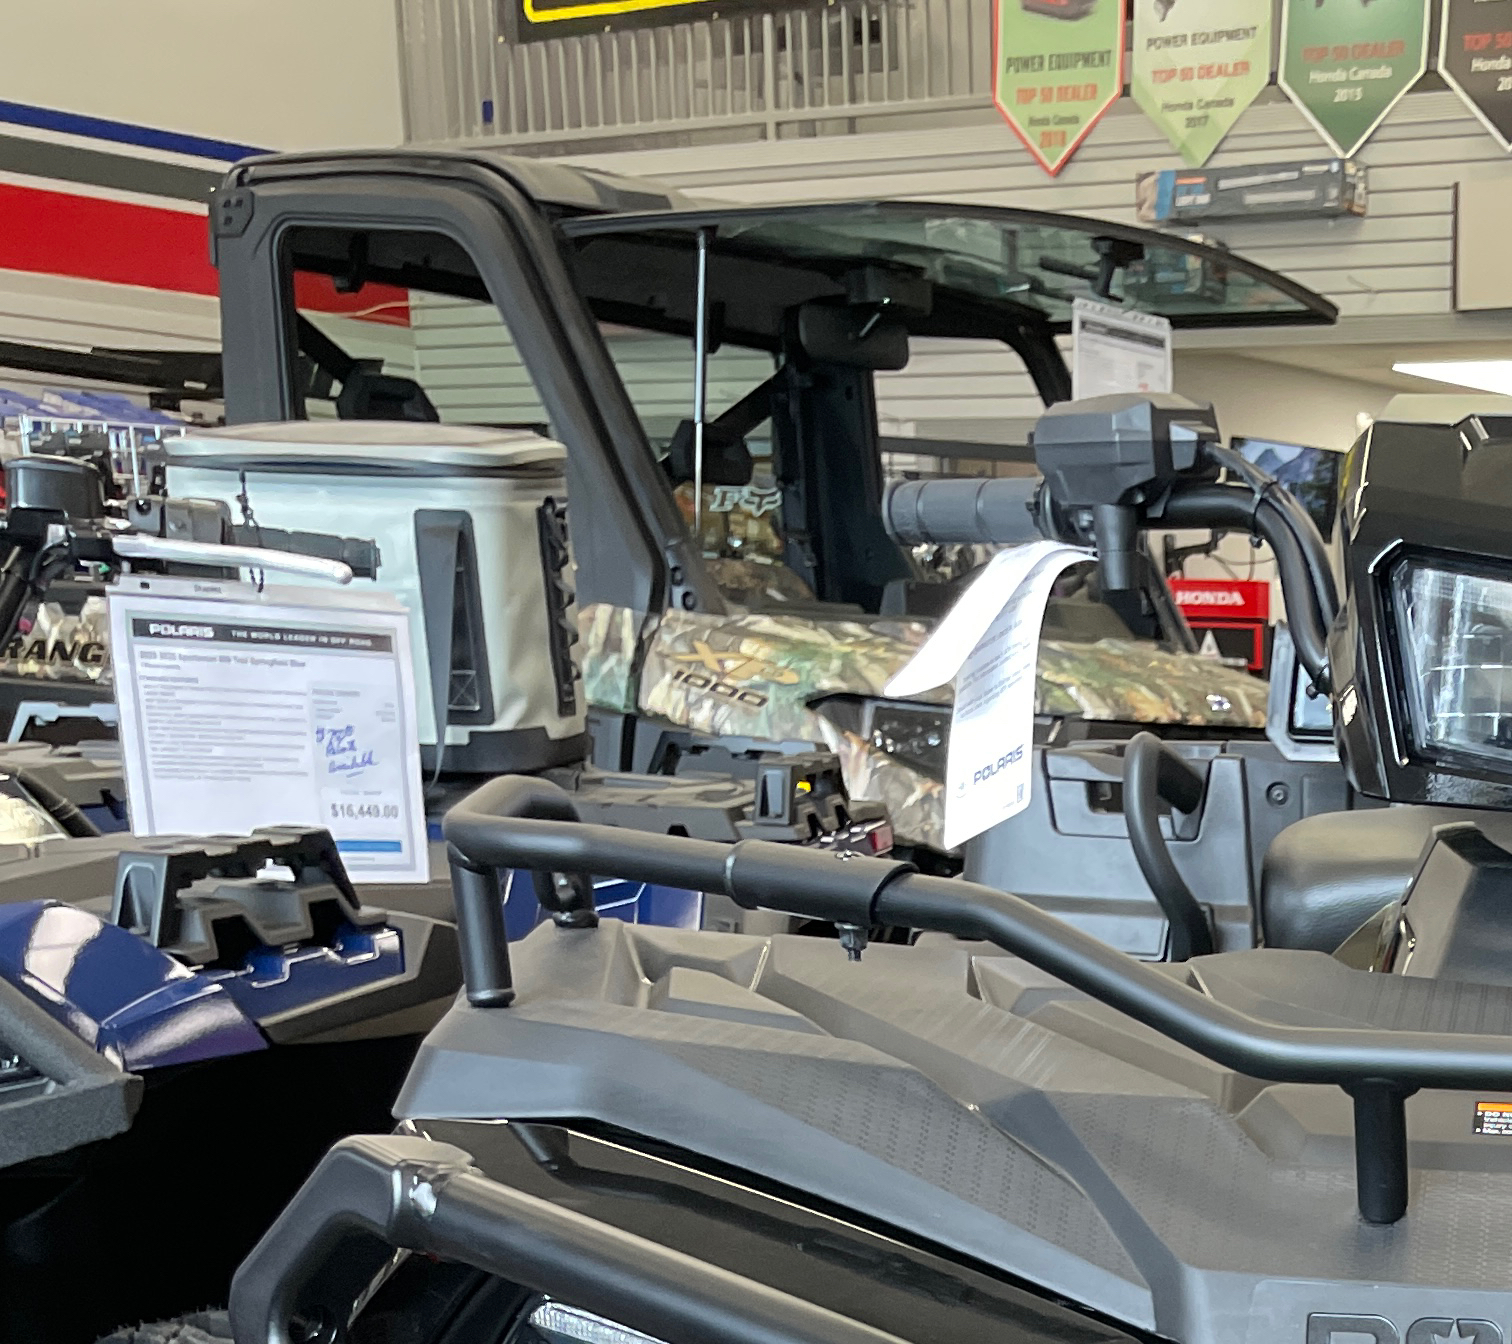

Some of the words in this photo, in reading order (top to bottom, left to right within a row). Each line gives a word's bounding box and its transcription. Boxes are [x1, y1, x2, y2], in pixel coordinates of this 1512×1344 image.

[1147, 34, 1188, 50] POWER
[1191, 26, 1257, 47] EQUIPMENT
[1463, 34, 1491, 51] TOP
[1005, 54, 1044, 74] POWER
[1048, 50, 1112, 71] EQUIPMENT
[1197, 60, 1251, 80] DEALER
[1471, 54, 1512, 72] Honda
[1309, 68, 1346, 84] Honda
[1348, 65, 1392, 81] Canada
[1175, 590, 1246, 606] HONDA
[149, 622, 215, 639] POLARIS
[674, 670, 768, 707] 1000
[974, 744, 1024, 785] POLARIS
